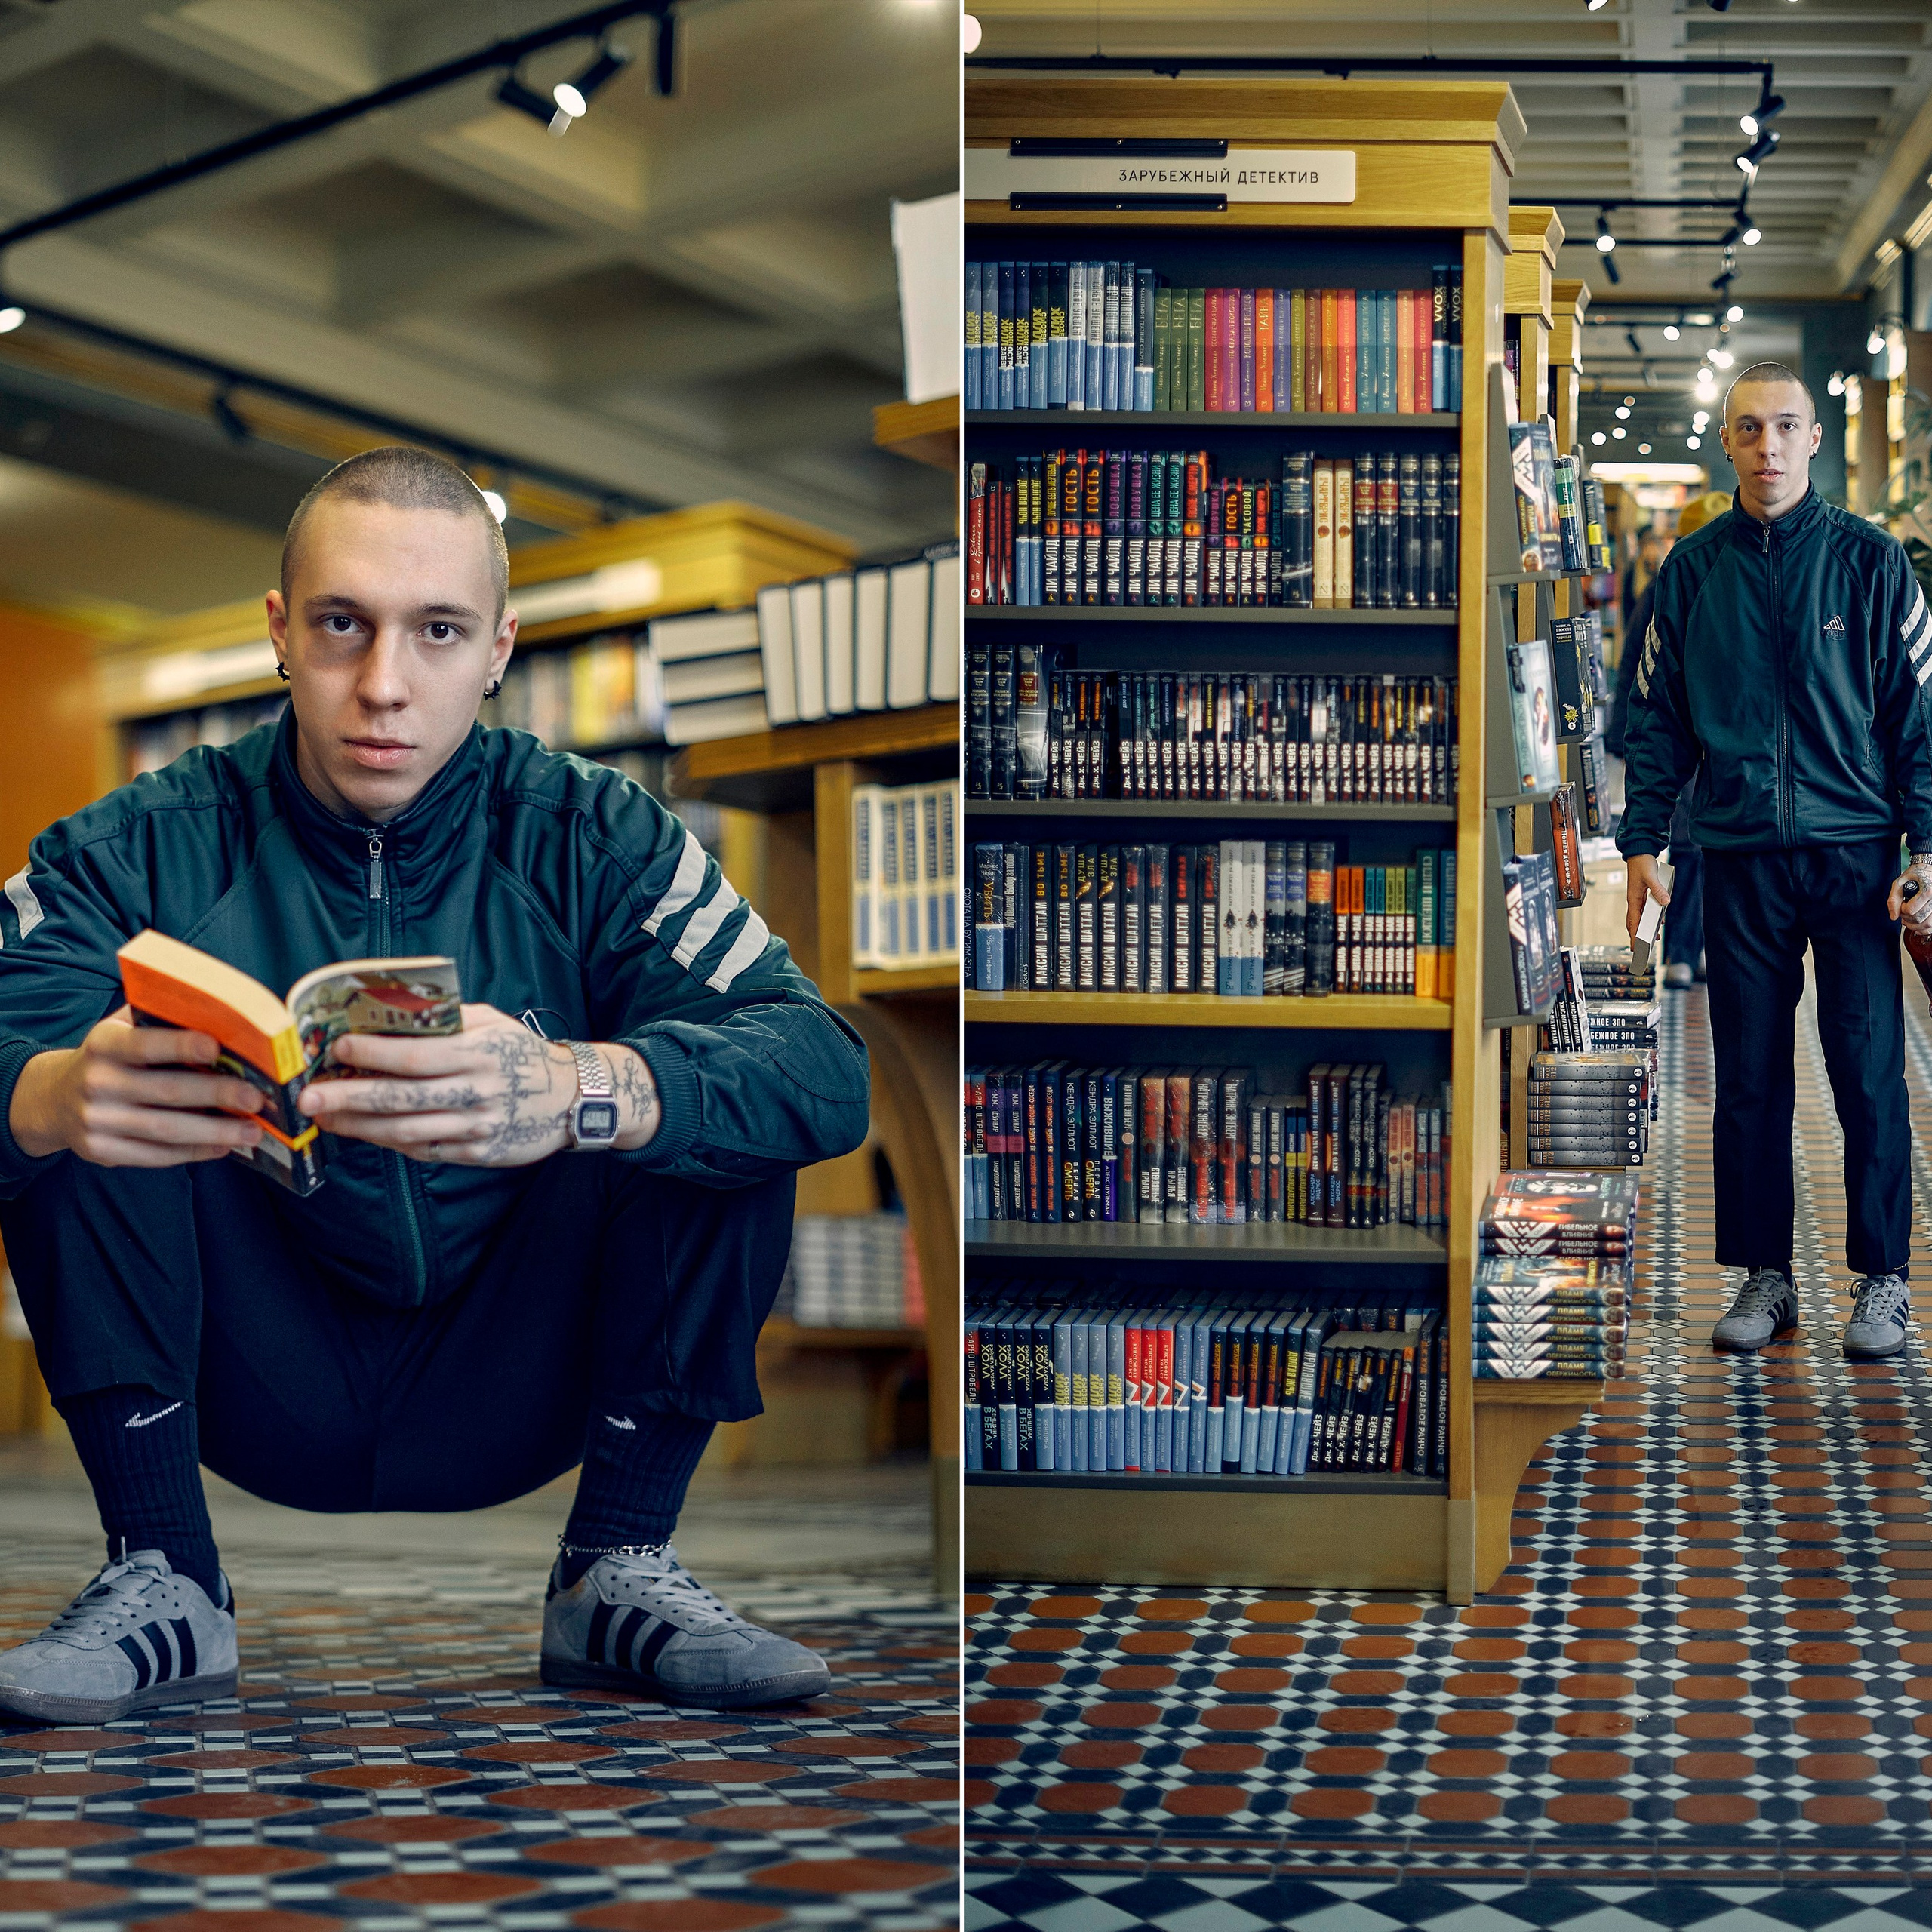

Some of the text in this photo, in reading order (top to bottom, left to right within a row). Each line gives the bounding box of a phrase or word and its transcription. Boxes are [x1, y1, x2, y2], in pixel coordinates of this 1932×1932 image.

[1118, 168, 1319, 186] ЗАРУБЕЖНЫЙ ДЕТЕКТИВ
[1073, 282, 1082, 306] СЛАБОЕ
[1091, 281, 1100, 341] СЛАБОЕ УТЕШЕНИЕ
[1106, 286, 1118, 335] ПРОПАВШИЕ
[1120, 286, 1132, 335] ПРОПАВШИЕ
[1156, 297, 1168, 328] БЕГА
[1173, 297, 1186, 328] БЕГА
[1190, 297, 1201, 328] БЕГА
[1259, 297, 1269, 331] ТАЙНА
[1001, 318, 1010, 346] ХИЛЛ
[1066, 469, 1078, 512] ГОСТЬ
[1087, 469, 1099, 512] ГОСТЬ
[1109, 464, 1120, 518] ЛОВУШКА
[1131, 464, 1142, 518] ЛОВУШКА
[1152, 465, 1161, 489] ЖИЗНИ
[1018, 480, 1029, 525] ДОЛГАЯ НОЧЬ
[1032, 480, 1041, 525] ДОЛГАЯ НОЧЬ
[1152, 499, 1162, 518] ЦЕНА
[1227, 494, 1238, 528] ГОСТЬ
[1242, 491, 1251, 533] ЧАСОВОЙ
[1319, 481, 1328, 522] ЧАРТЕРИС
[1340, 481, 1349, 523] ЧАРТЕРИС
[1044, 540, 1060, 593] ЛИ ЧАЙЛД
[1063, 540, 1079, 593] ЛИ ЧАЙЛД
[1084, 540, 1100, 593] ЛИ ЧАЙЛД
[1048, 741, 1058, 764] ЧЕЙЗ
[1091, 740, 1100, 764] ЧЕЙЗ
[1147, 741, 1157, 765] ЧЕЙЗ
[1004, 853, 1014, 869] тобой
[1078, 853, 1087, 882] ДУША
[1101, 853, 1109, 882] ДУША
[1563, 854, 1571, 884] девочка
[1004, 877, 1016, 895] Выбор
[1037, 883, 1044, 896] ВО
[1060, 884, 1068, 897] ВО
[1036, 902, 1048, 983] МАКСИМ ШАТТАМ
[1060, 903, 1070, 984] МАКСИМ ШАТТАМ
[1081, 904, 1093, 986] МАКСИМ ШАТТАМ
[1612, 1018, 1626, 1026] ЗЛО
[1621, 1032, 1635, 1040] ЗЛО
[1088, 1081, 1096, 1114] КЕНДРА
[1198, 1084, 1208, 1140] КАТРИНЕ ЭНГБЕРГ
[1226, 1084, 1236, 1140] КАТРИНЕ ЭНГБЕРГ
[975, 1091, 984, 1153] АРНО ШТРОБЕЛЬ
[1066, 1082, 1075, 1150] КЕНДРА ЭЛЛИОТ
[1103, 1097, 1114, 1155] ВЫЖИВШИЕ
[1064, 1161, 1073, 1201] СМЕРТЬ
[1085, 1161, 1094, 1199] СМЕРТЬ
[1142, 1171, 1150, 1198] КРЫЛЬЯ
[1151, 1168, 1160, 1202] СТЕКЛЯННЫЕ
[1558, 1223, 1598, 1232] ГИБЕЛЬНОЕ
[1556, 1290, 1585, 1298] ПЛАМЯ
[981, 1344, 990, 1379] ХОЛЛ
[1017, 1345, 1026, 1380] ХОЛЛ
[1285, 1351, 1298, 1395] ДОЛГАЯ НОЧЬ
[1300, 1352, 1316, 1400] ПРОПАВШИЕ
[968, 1361, 977, 1402] ШТРОБЕЛЬ
[1055, 1373, 1065, 1404] ХИЛЛ
[1090, 1374, 1100, 1405] ХИЛЛ
[1419, 1380, 1427, 1425] КРОВАВОЕ
[1438, 1378, 1447, 1455] КРОВАВОЕ РАНЧО
[984, 1416, 993, 1450] БЕГАХ
[1019, 1417, 1028, 1451] БЕГАХ
